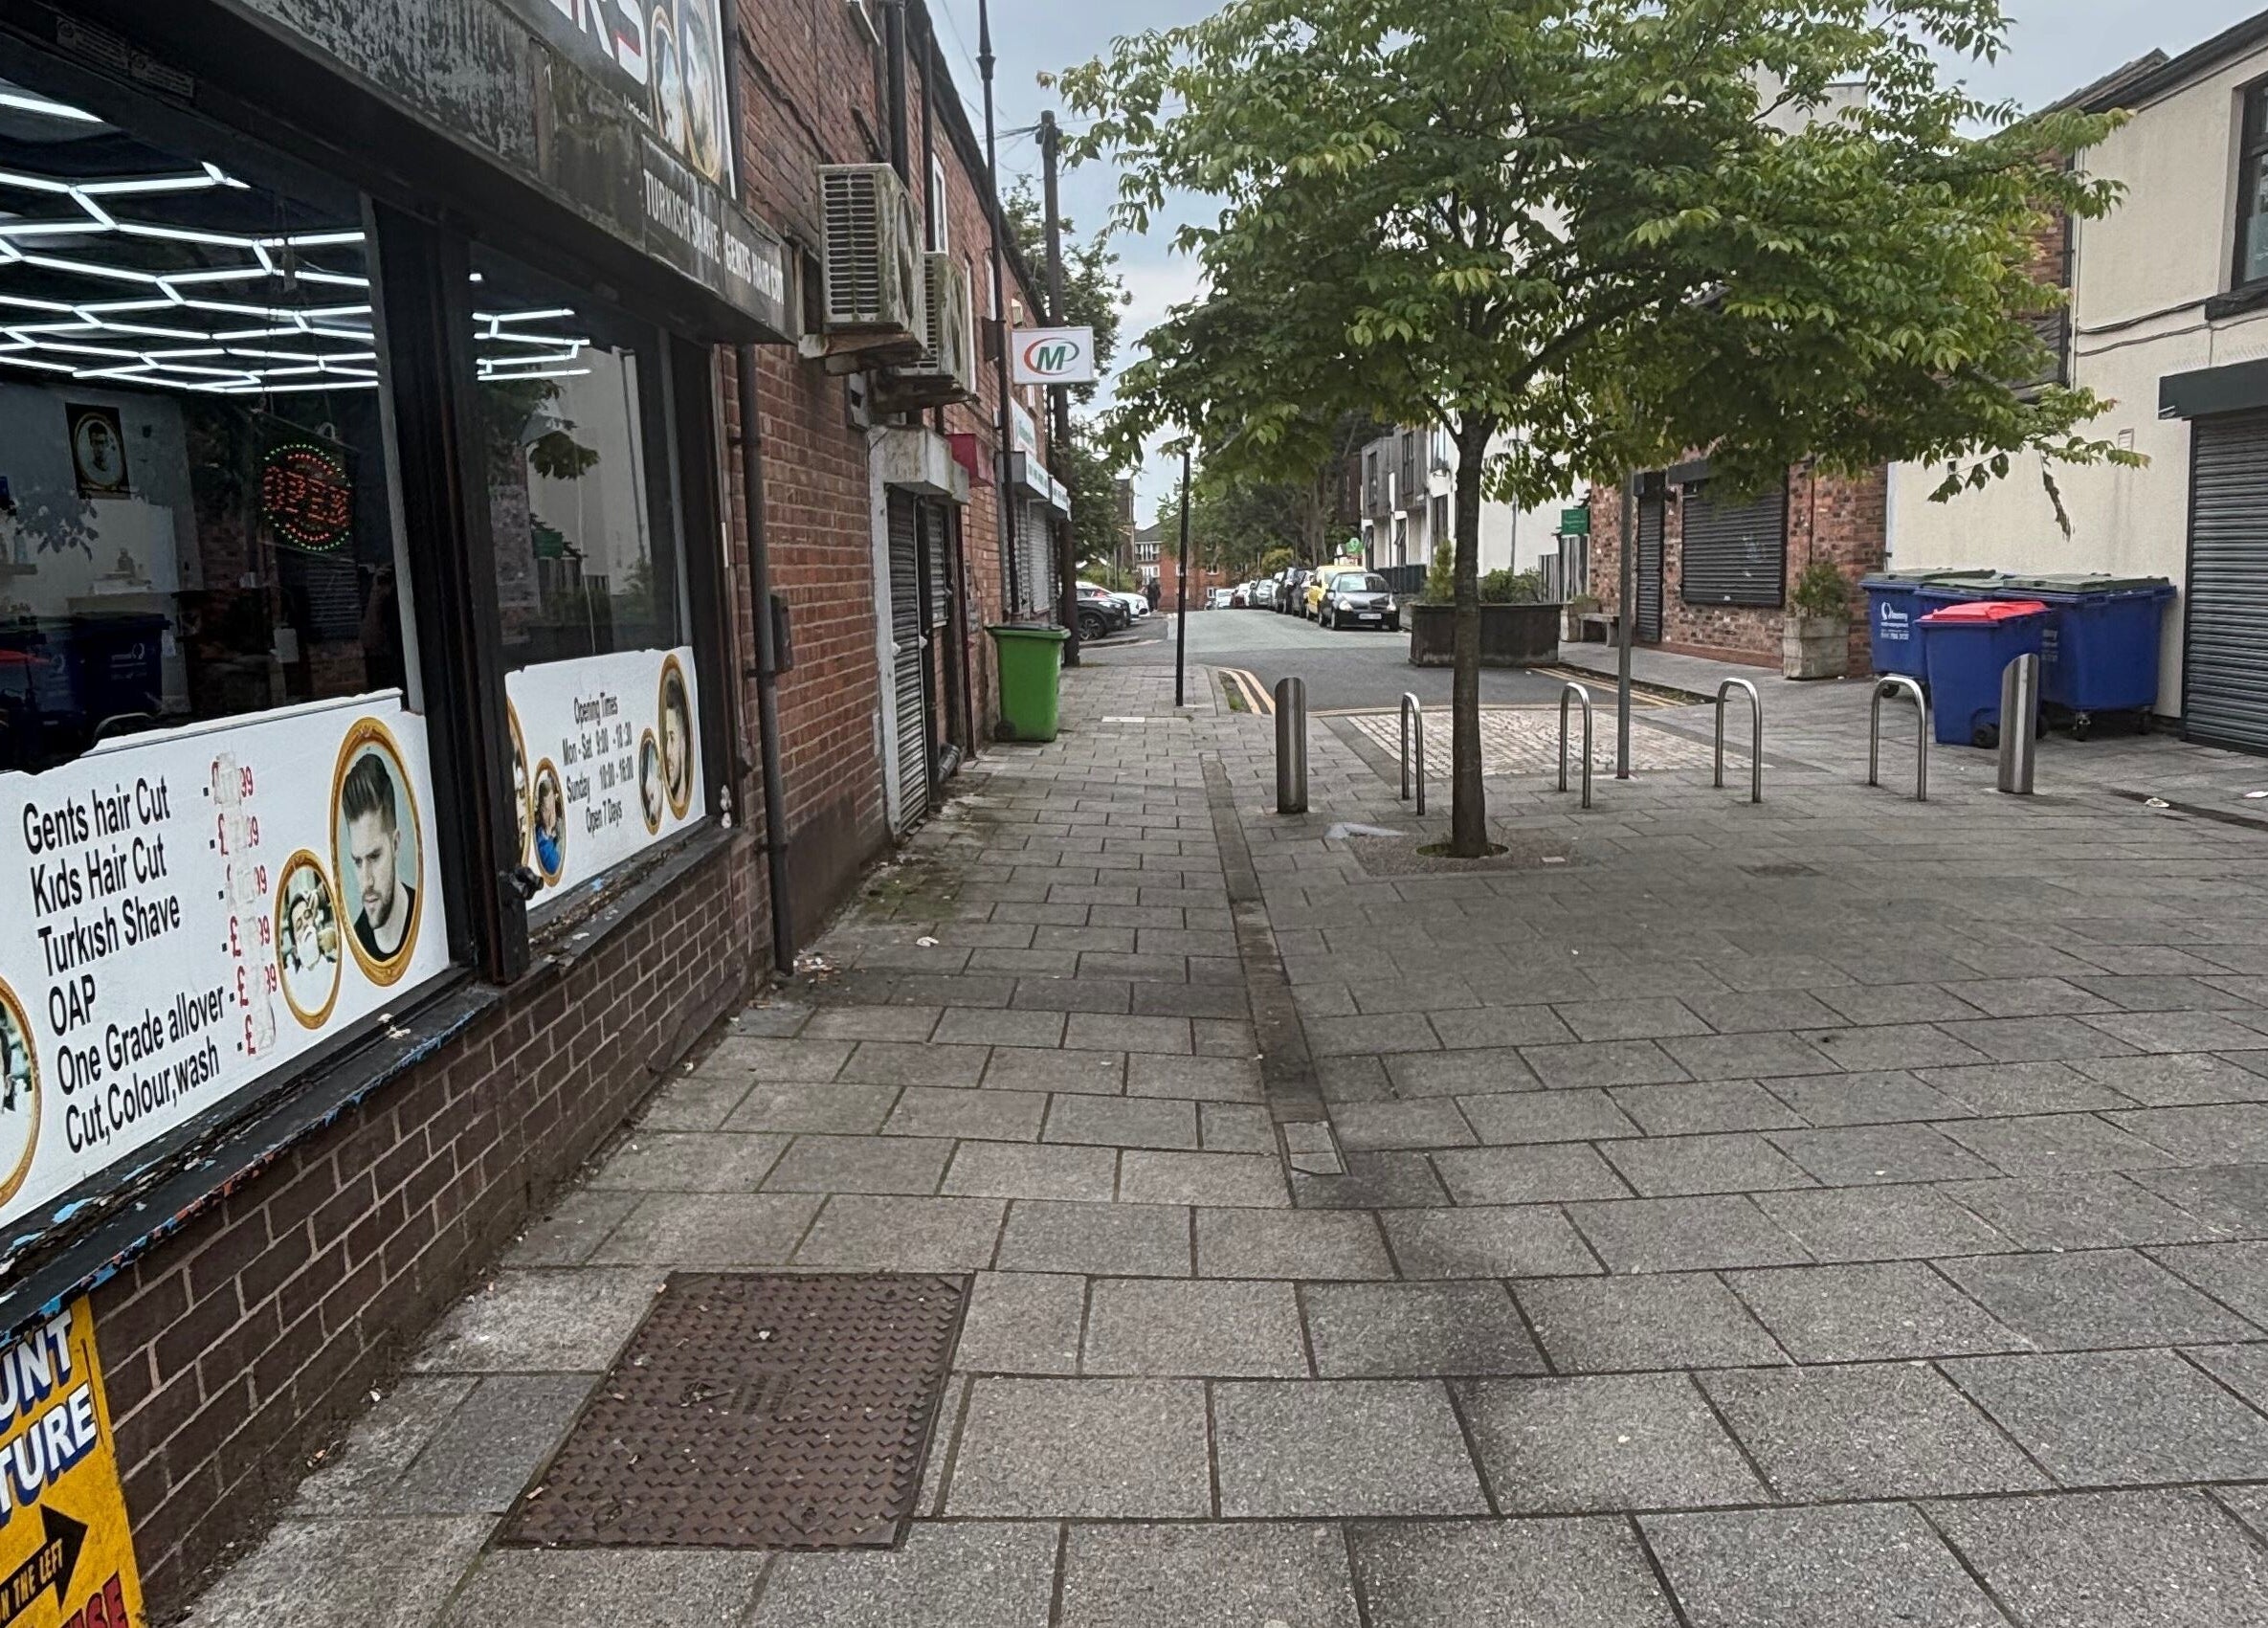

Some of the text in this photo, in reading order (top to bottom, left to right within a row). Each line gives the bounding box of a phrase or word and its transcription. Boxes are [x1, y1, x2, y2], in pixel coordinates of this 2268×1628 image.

[643, 168, 690, 243] TURKISH
[724, 231, 751, 284] GENTS
[563, 738, 577, 766] Mon
[582, 733, 593, 760] Sat
[567, 771, 590, 804] Sunday
[23, 796, 89, 855] Gents
[92, 783, 130, 836] hair
[136, 775, 170, 825] Cut
[586, 806, 604, 838] Open
[608, 798, 622, 827] Days
[31, 833, 167, 917] Kids Hair Cut
[37, 895, 181, 977] Turkish Shave
[49, 973, 96, 1037] OAP
[57, 986, 223, 1095] One Grade allover
[12, 1564, 35, 1609] THE
[39, 1537, 63, 1585] LEFT
